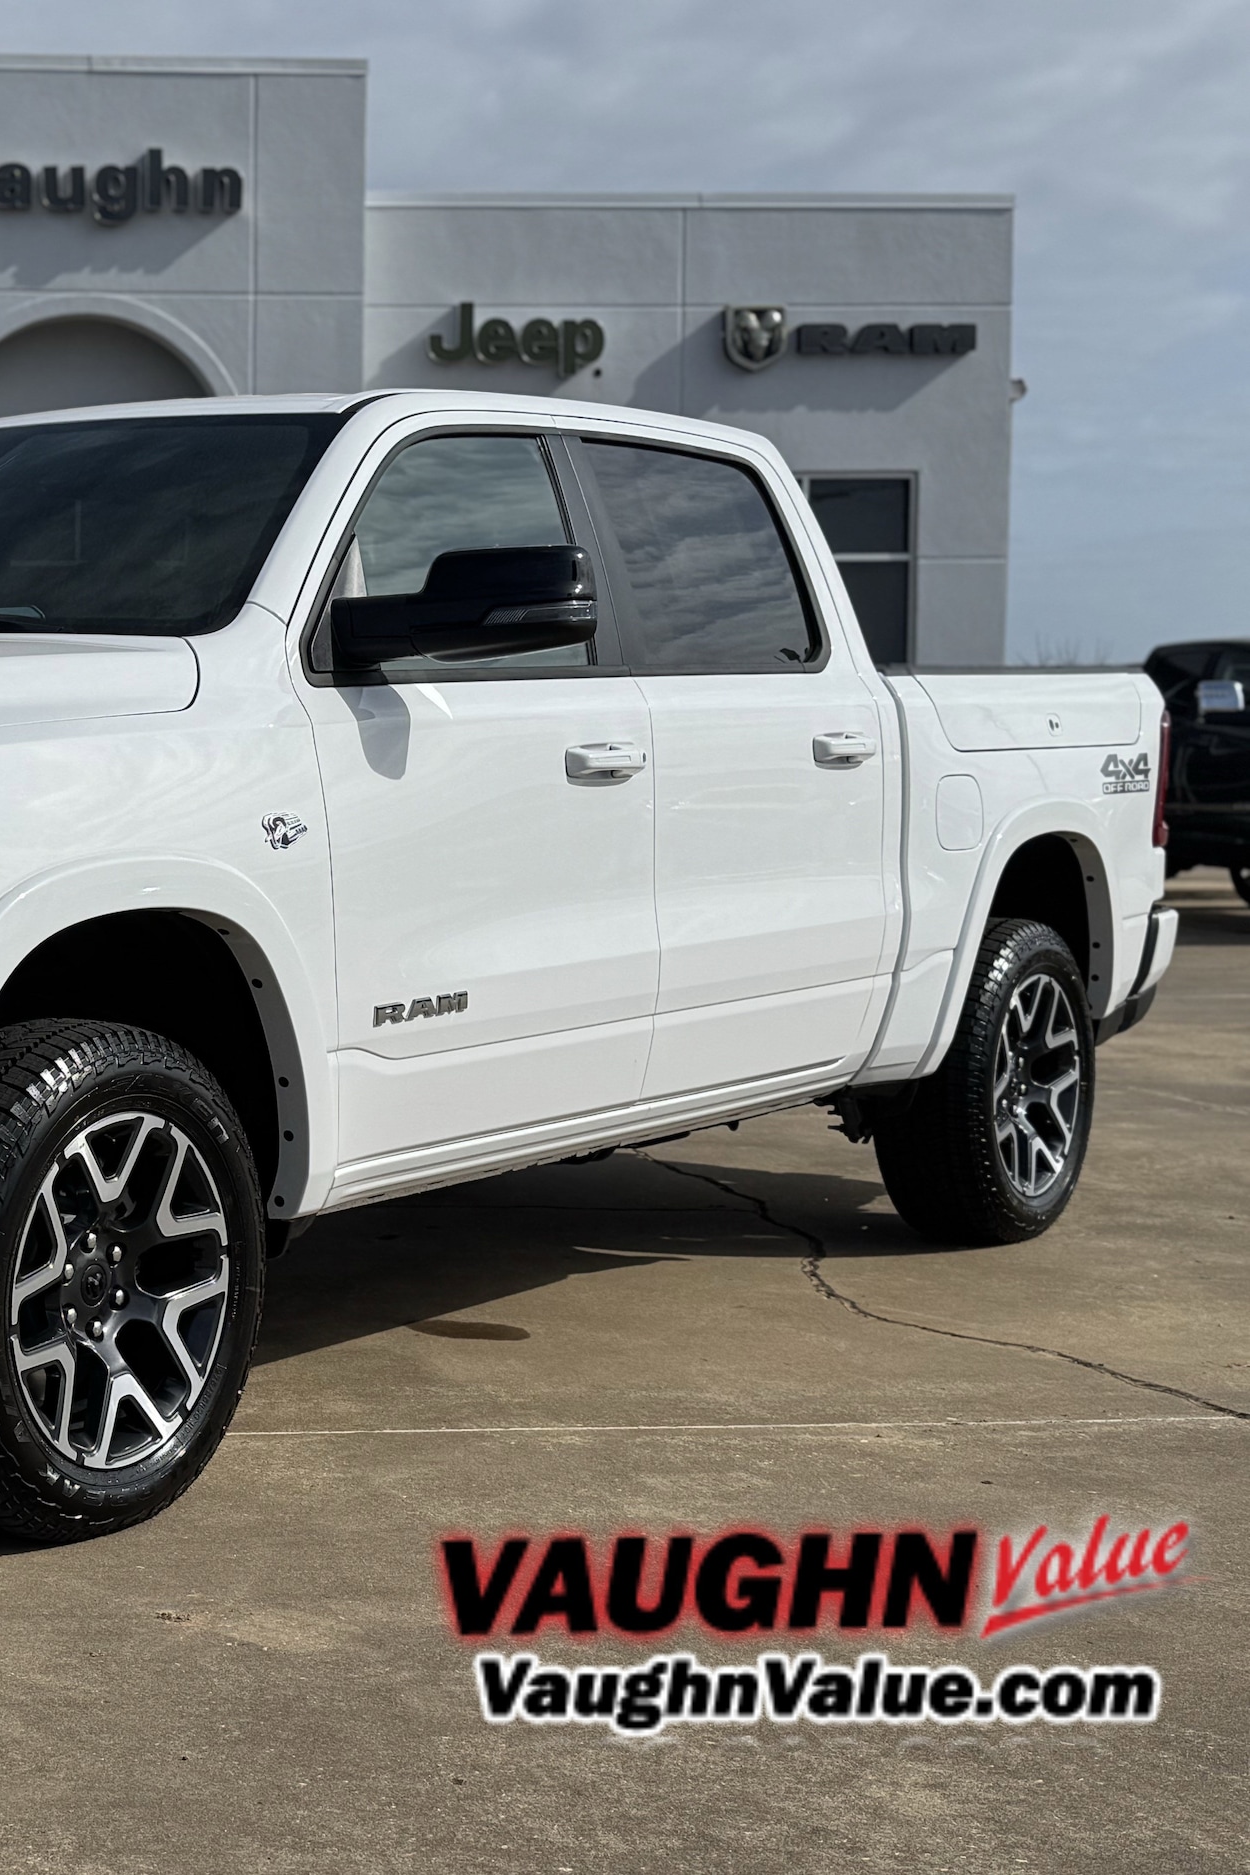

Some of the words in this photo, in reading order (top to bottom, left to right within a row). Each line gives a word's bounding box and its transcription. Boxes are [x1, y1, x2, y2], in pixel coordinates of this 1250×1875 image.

[428, 302, 605, 376] Jeep
[797, 324, 976, 355] RAM
[1100, 753, 1151, 780] 4x4
[1103, 783, 1123, 793] OFF
[1125, 781, 1149, 791] ROAD
[373, 991, 468, 1028] RAM
